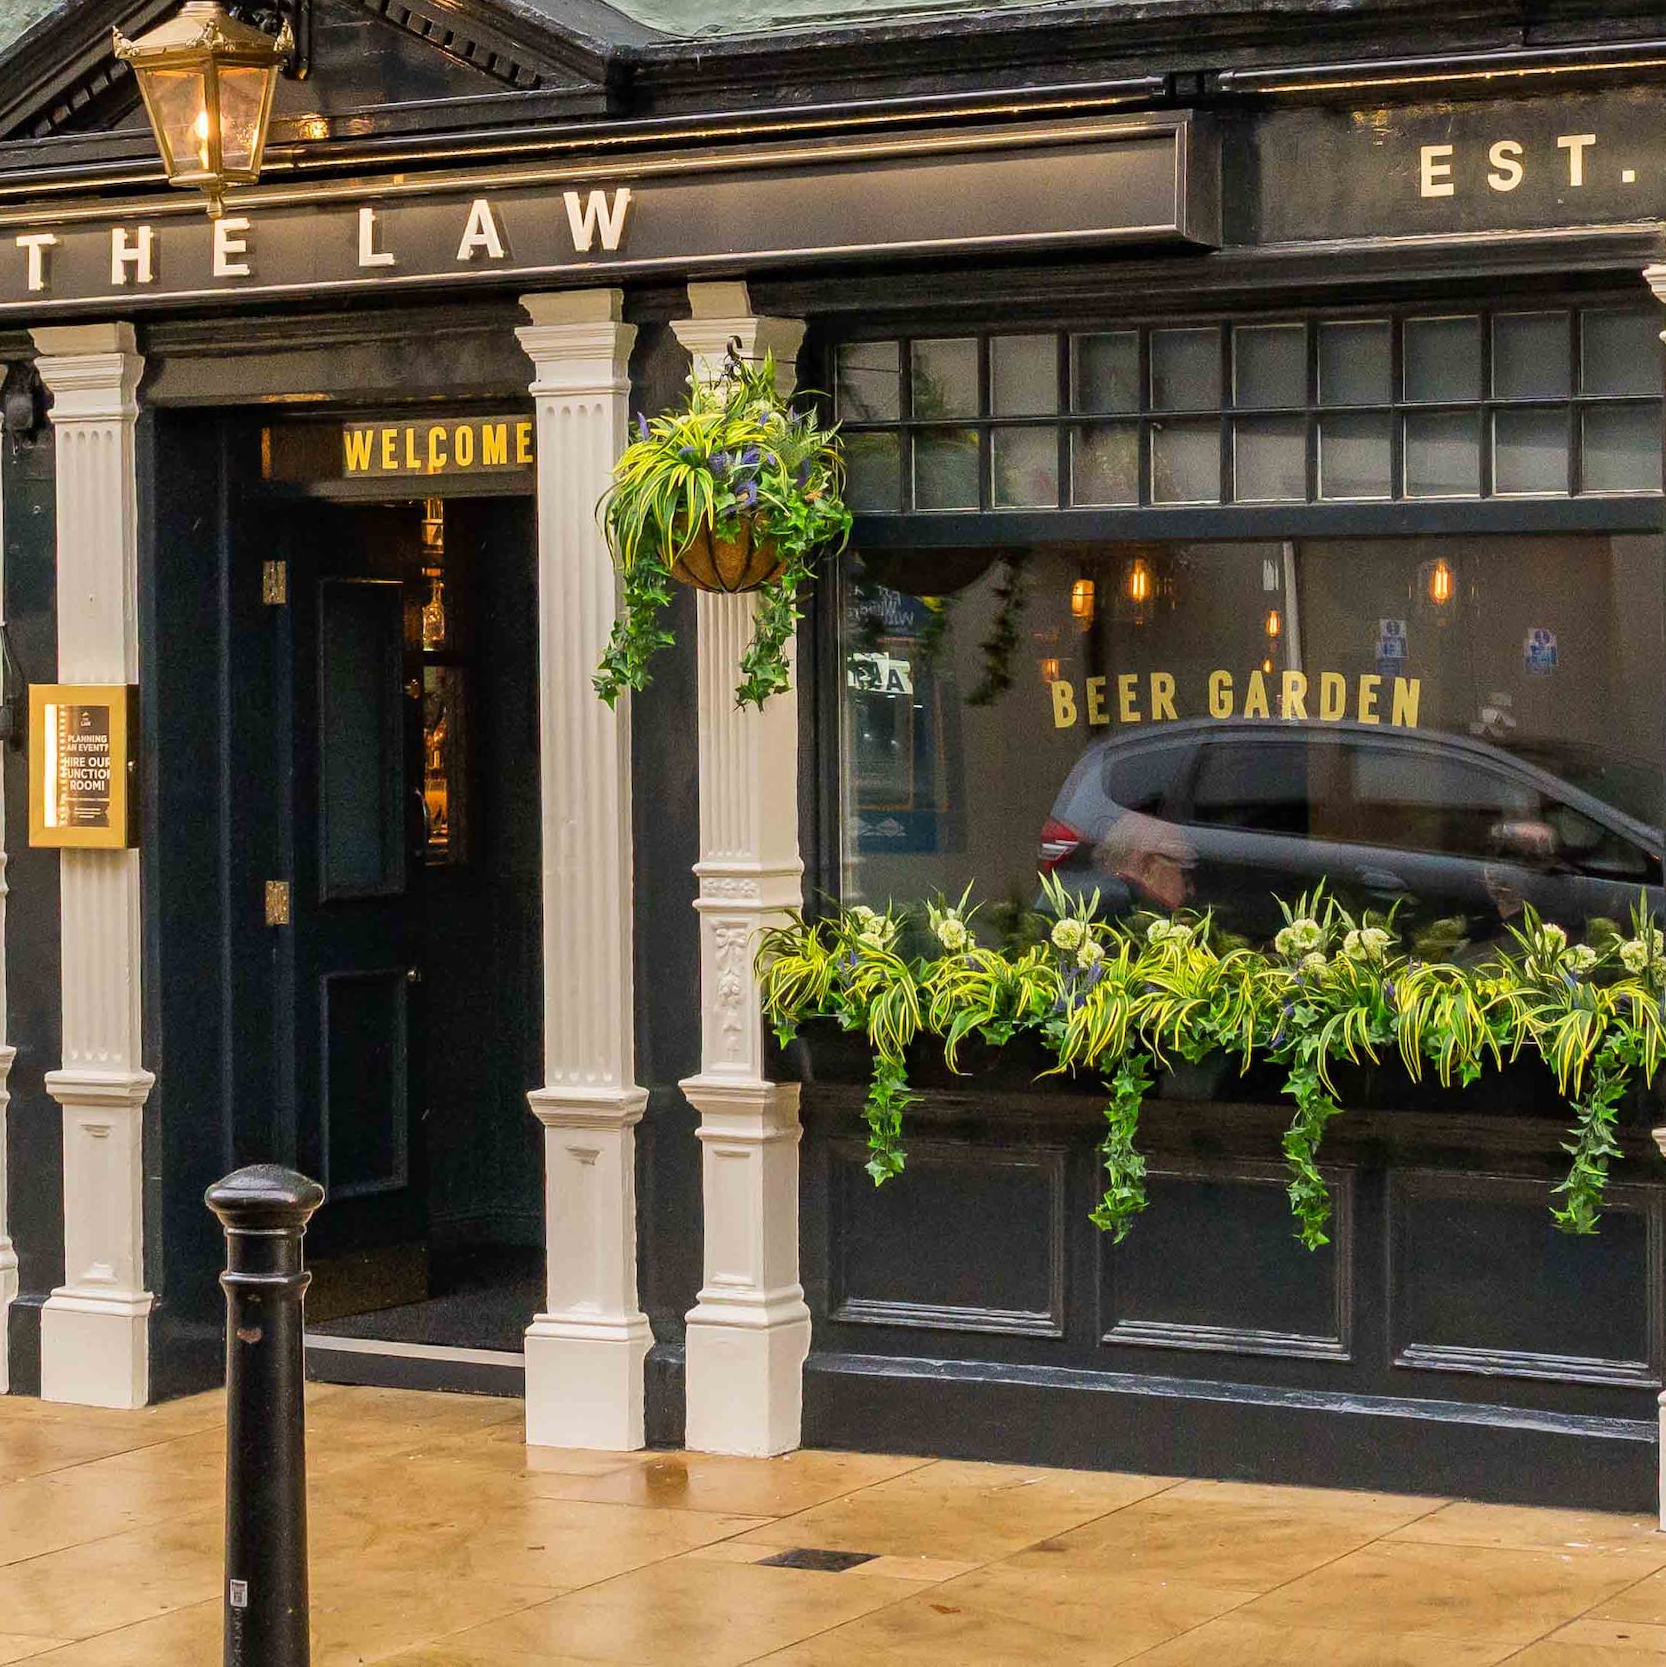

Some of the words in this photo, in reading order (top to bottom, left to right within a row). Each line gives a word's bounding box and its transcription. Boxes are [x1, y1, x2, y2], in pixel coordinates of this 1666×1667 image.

[1419, 133, 1636, 198] EST.
[16, 217, 251, 292] THE
[357, 187, 632, 267] LAW
[343, 422, 534, 471] WELCOME
[1051, 670, 1176, 729] BEER
[1208, 669, 1422, 729] GARDEN
